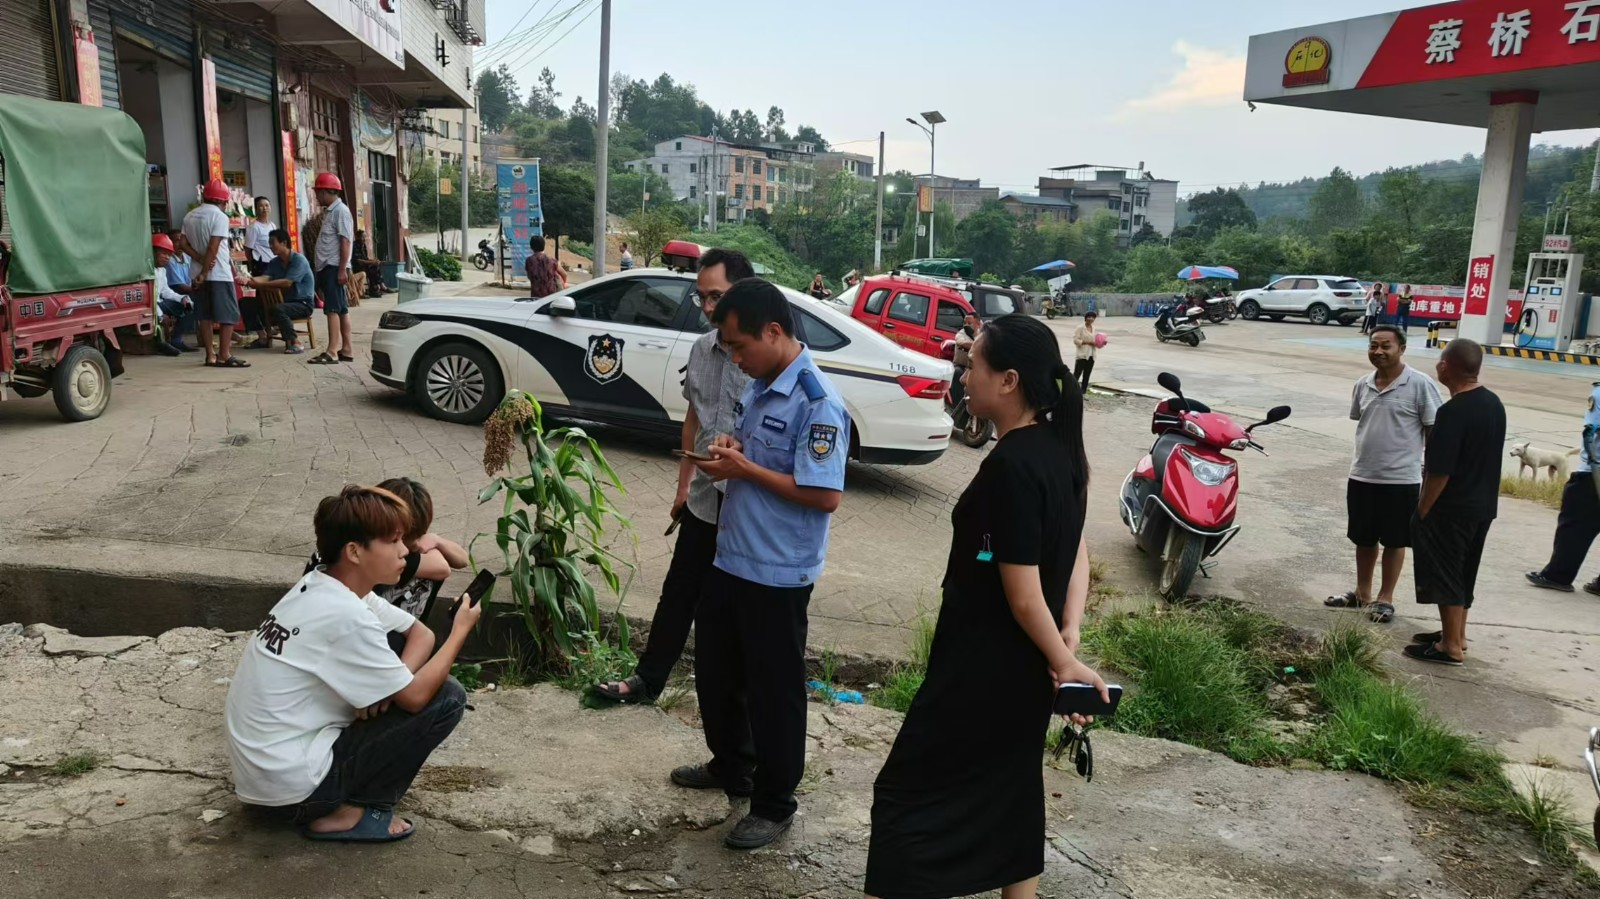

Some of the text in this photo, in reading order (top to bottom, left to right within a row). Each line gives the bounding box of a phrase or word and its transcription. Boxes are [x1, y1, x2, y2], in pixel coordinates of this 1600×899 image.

[1424, 1, 1600, 65] 蔡桥石
[1470, 262, 1490, 299] 销处
[20, 301, 45, 317] 中国
[889, 362, 916, 374] 1168
